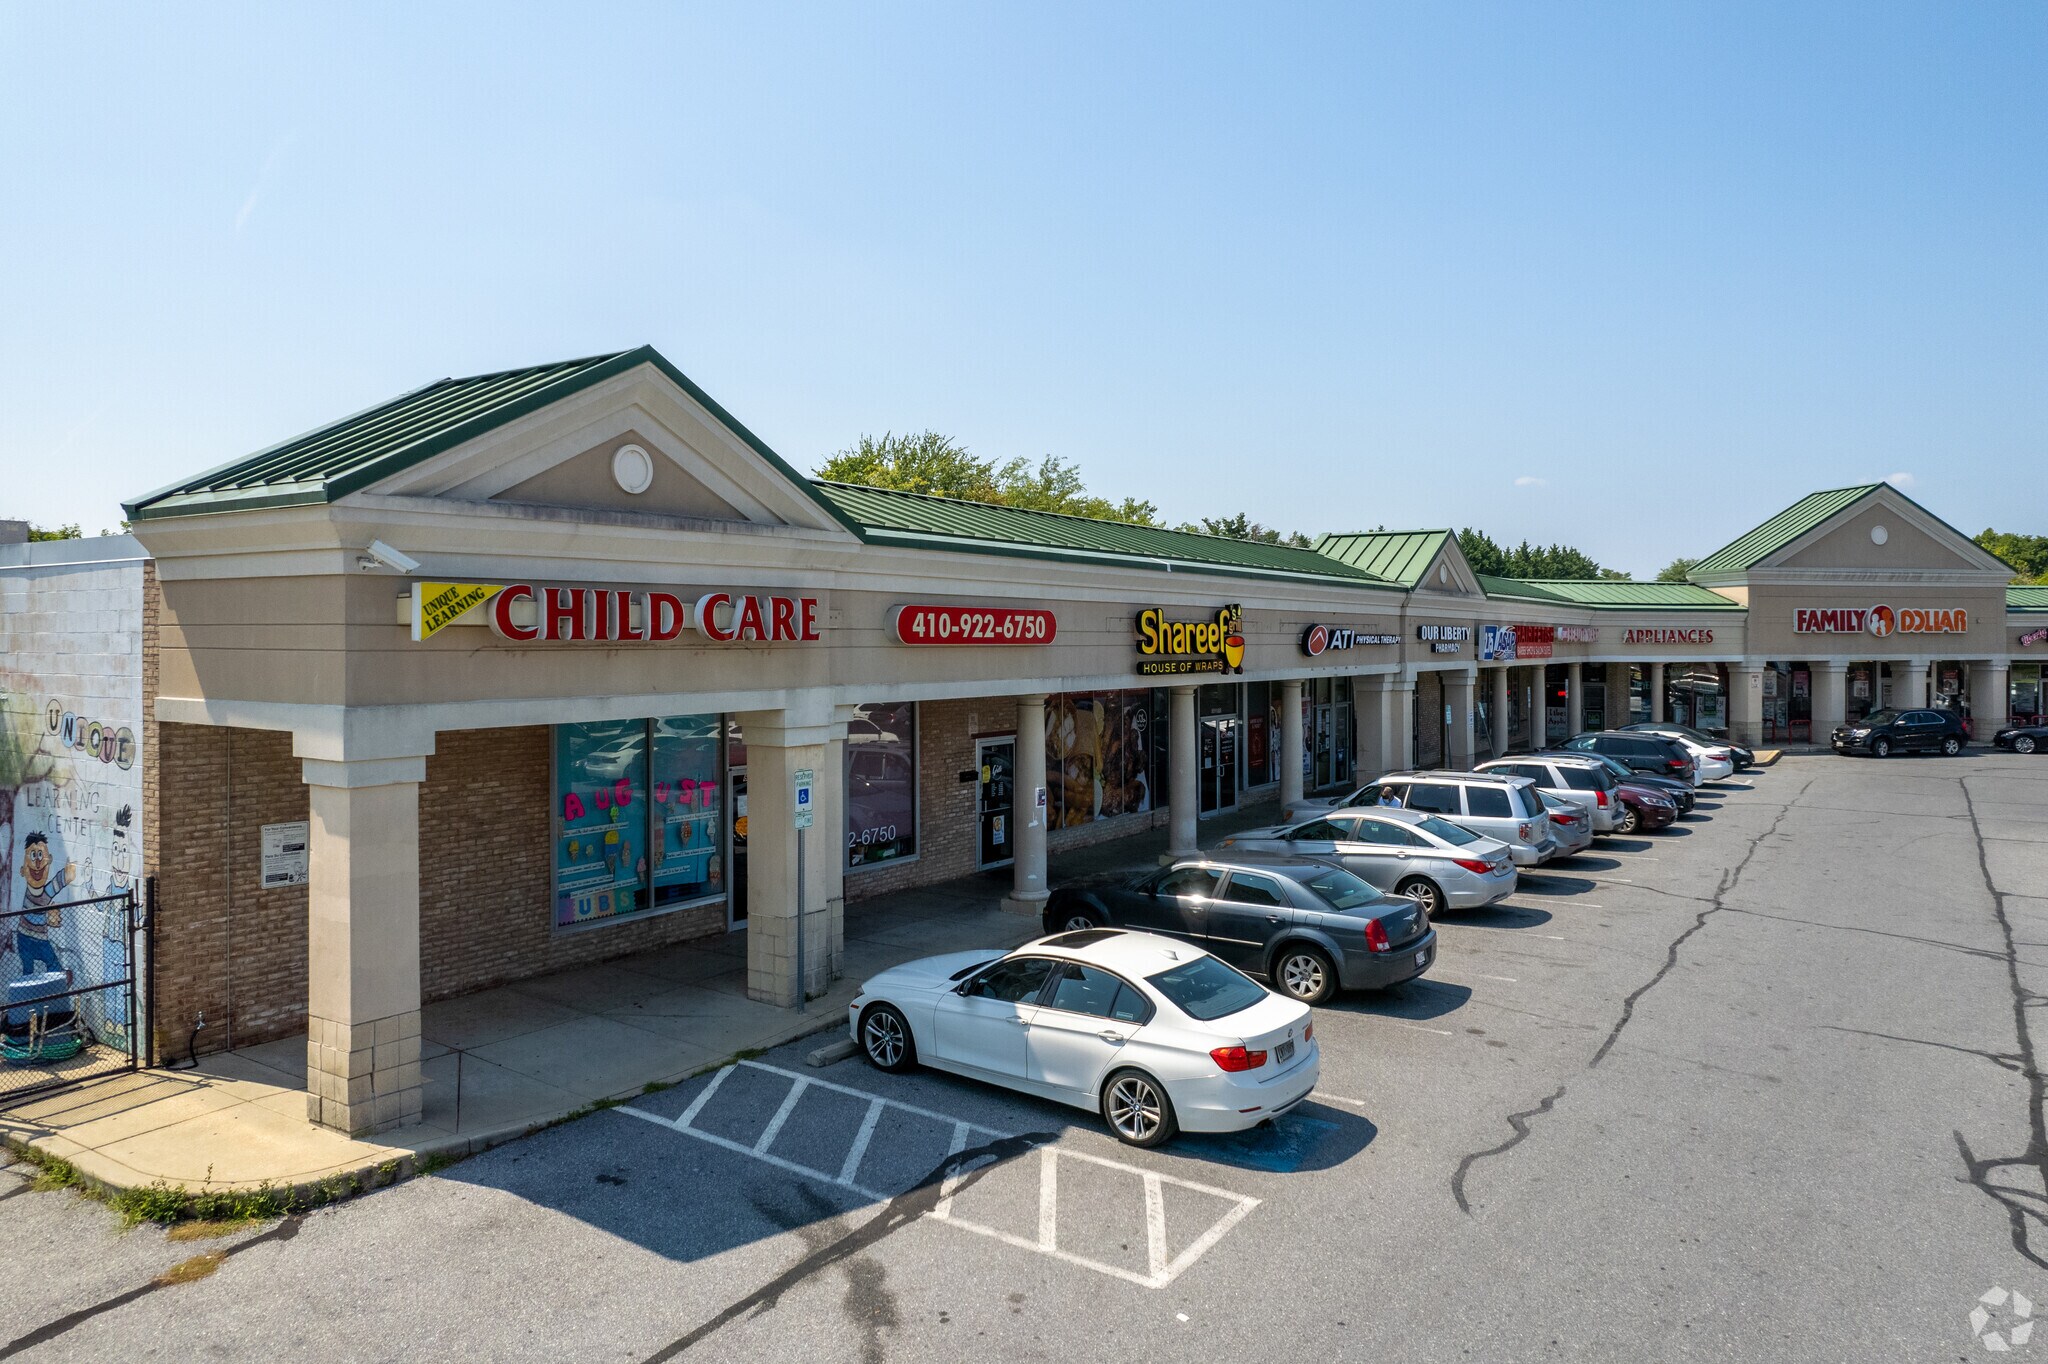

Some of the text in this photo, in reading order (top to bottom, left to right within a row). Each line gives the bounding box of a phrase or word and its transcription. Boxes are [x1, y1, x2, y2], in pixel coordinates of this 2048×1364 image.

[423, 586, 460, 616] UNIQUE
[425, 587, 485, 632] LEARNING
[489, 584, 822, 642] CHILD CARE
[912, 612, 1046, 639] 410-922-6750
[1421, 625, 1471, 641] OUR LIBERTY
[1796, 609, 1967, 632] FAMILY DOLLAR
[1329, 629, 1402, 650] ATI PHYSICAL THERAPY
[1499, 629, 1517, 651] ASAP
[1625, 629, 1714, 643] APPLIANCES
[1143, 660, 1224, 674] HOUSE OF WRAPS
[47, 707, 132, 765] UNIQUE
[26, 785, 100, 814] LEARNING
